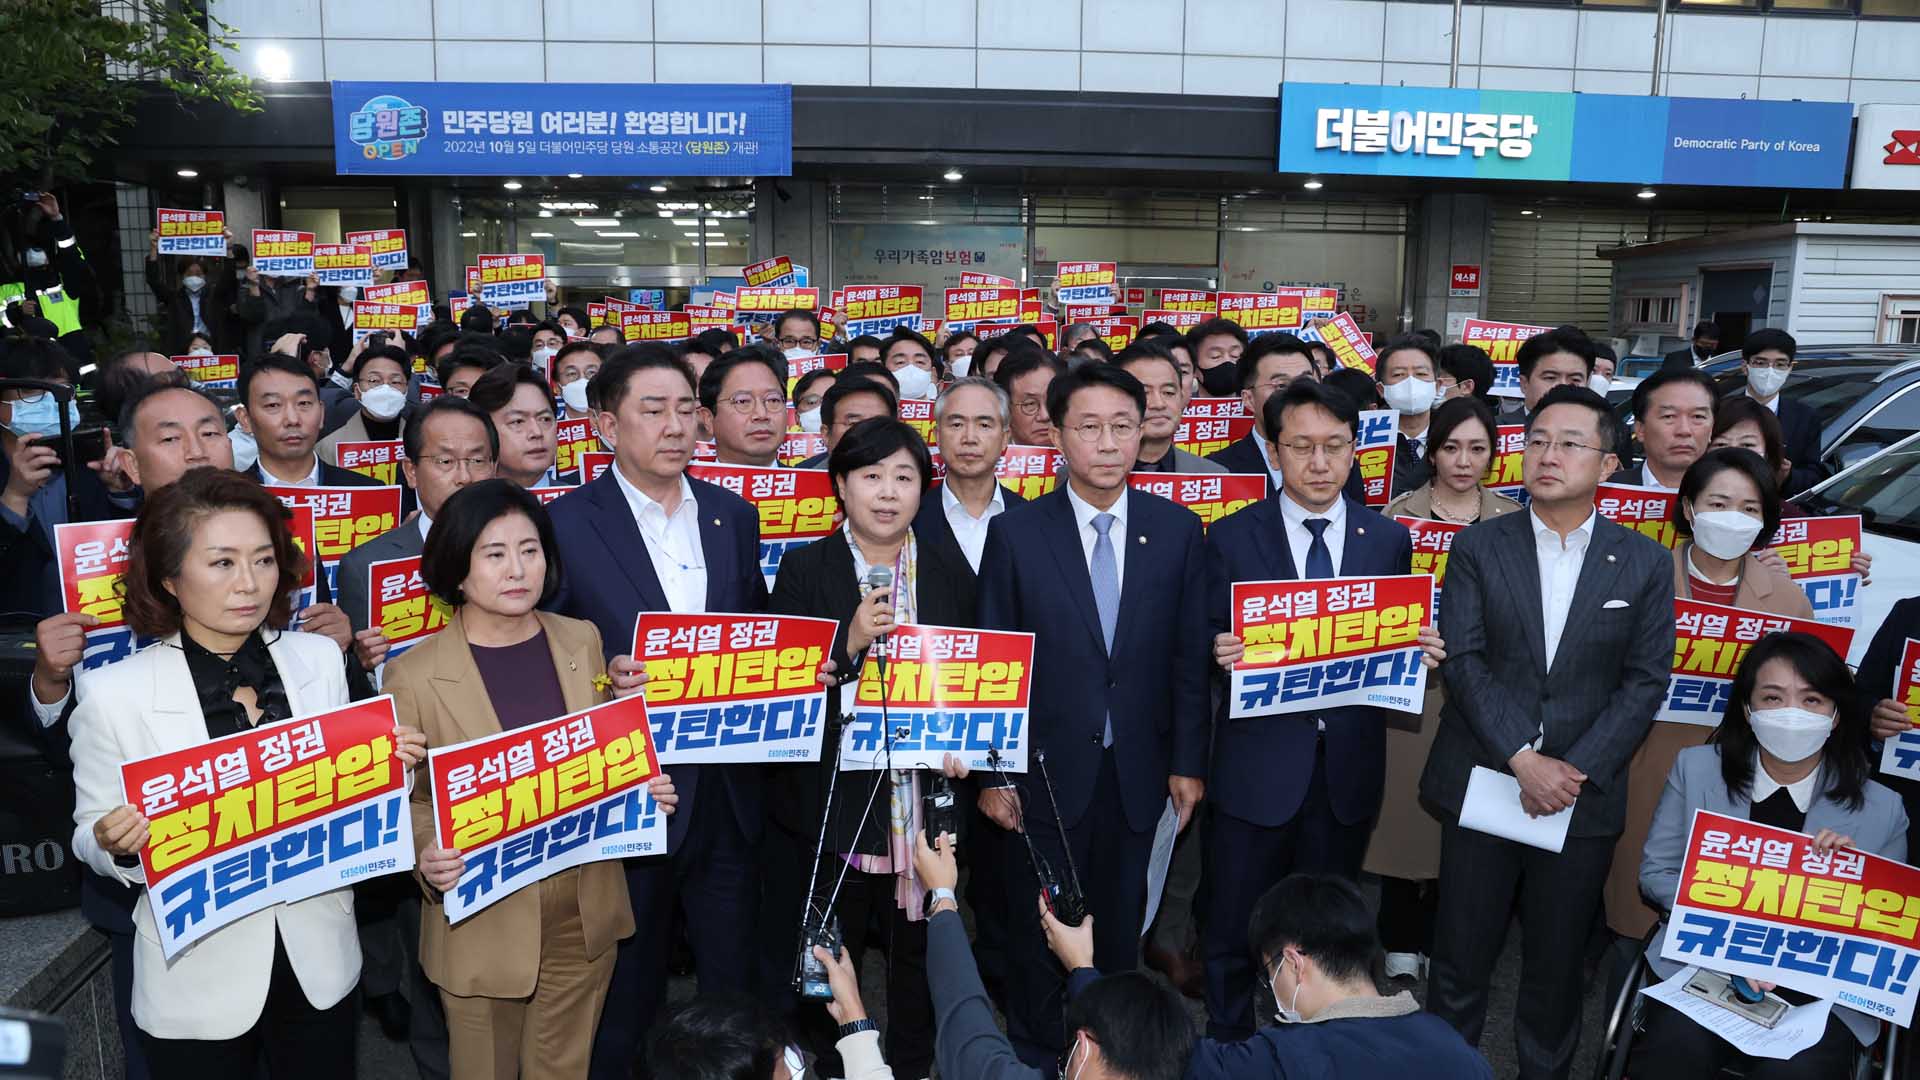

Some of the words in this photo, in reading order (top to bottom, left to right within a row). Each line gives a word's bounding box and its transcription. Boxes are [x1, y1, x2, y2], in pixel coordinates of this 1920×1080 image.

[350, 108, 425, 141] 당원존
[442, 110, 534, 135] 민주당원
[540, 111, 617, 135] 여러분!
[624, 111, 747, 136] 환영합니다!
[1315, 108, 1539, 159] 더불어민주당
[363, 142, 418, 160] OPEN
[443, 140, 486, 154] 2022년
[489, 141, 514, 155] 10월
[518, 141, 537, 154] 5일
[539, 141, 609, 155] 더불어민주당
[611, 141, 635, 155] 당원
[636, 141, 683, 155] 소통공간
[732, 142, 759, 155] 개관!
[1673, 136, 1738, 150] Democratic
[1741, 138, 1771, 152] Party
[1774, 141, 1786, 151] of
[1788, 141, 1821, 153] Korea
[160, 221, 223, 236] 정치탄압
[161, 237, 225, 251] 규탄한다!
[256, 242, 312, 257] 정치탄압
[256, 257, 313, 271] 규탄한다!
[315, 254, 369, 268] 정치탄압
[874, 249, 972, 265] 우리가족암보험
[482, 263, 542, 282] 정치탄압
[1060, 271, 1114, 286] 정치탄압
[1455, 273, 1476, 282] 에스원
[483, 281, 544, 298] 규탄한다!
[847, 289, 877, 302] 윤석열
[879, 287, 900, 299] 정권
[949, 289, 978, 302] 윤석열
[979, 288, 999, 301] 정권
[1164, 293, 1191, 302] 윤석열
[1191, 292, 1207, 301] 정권
[738, 294, 816, 310] 정치탄압
[847, 296, 920, 319] 정치탄압
[948, 299, 1018, 320] 정치탄압
[1220, 297, 1254, 309] 윤석열
[1257, 295, 1278, 308] 정권
[357, 313, 416, 328] 정치탄압
[624, 322, 689, 341] 정치탄압
[1468, 326, 1512, 339] 윤석열
[800, 357, 825, 371] 정권
[901, 403, 931, 419] 정권
[557, 423, 587, 442] 석열
[1195, 419, 1230, 440] 정권
[343, 446, 390, 467] 윤석열
[752, 472, 797, 498] 정권
[1180, 477, 1222, 502] 정권
[756, 495, 838, 534] 탄압
[1599, 497, 1667, 520] 윤석열
[315, 512, 395, 556] 탄압
[1781, 538, 1855, 576] 탄압
[1241, 589, 1319, 624] 윤석열
[1326, 581, 1376, 612] 정권
[1242, 602, 1425, 665] 정치탄압
[1675, 611, 1729, 639] 석열
[644, 623, 723, 657] 윤석열
[729, 620, 780, 650] 정권
[929, 633, 979, 660] 정권
[644, 645, 824, 703] 정치탄압
[858, 660, 1025, 703] 정치탄압
[1240, 649, 1425, 711] 규탄한다!
[1367, 693, 1411, 707] 더불어민주당
[648, 697, 823, 754] 규탄한다!
[852, 711, 1025, 752] 규탄한다!
[447, 739, 536, 802] 윤석열
[542, 714, 596, 763] 정권
[768, 749, 810, 758] 더불어민주당
[140, 746, 251, 817] 윤석열
[257, 720, 326, 773] 정권
[450, 727, 652, 850] 정치탄압
[147, 733, 393, 873] 정치탄압
[457, 786, 656, 909] 규탄한다!
[601, 841, 653, 856] 더불어민주당
[1699, 829, 1793, 870] 윤석열
[1801, 844, 1866, 881] 정권
[160, 794, 402, 941] 규탄한다!
[339, 857, 397, 880] 더불어민주당
[1688, 859, 1920, 941] 정치탄압
[1676, 912, 1920, 996] 규탄한다!
[1838, 990, 1896, 1017] 더불어민주당
